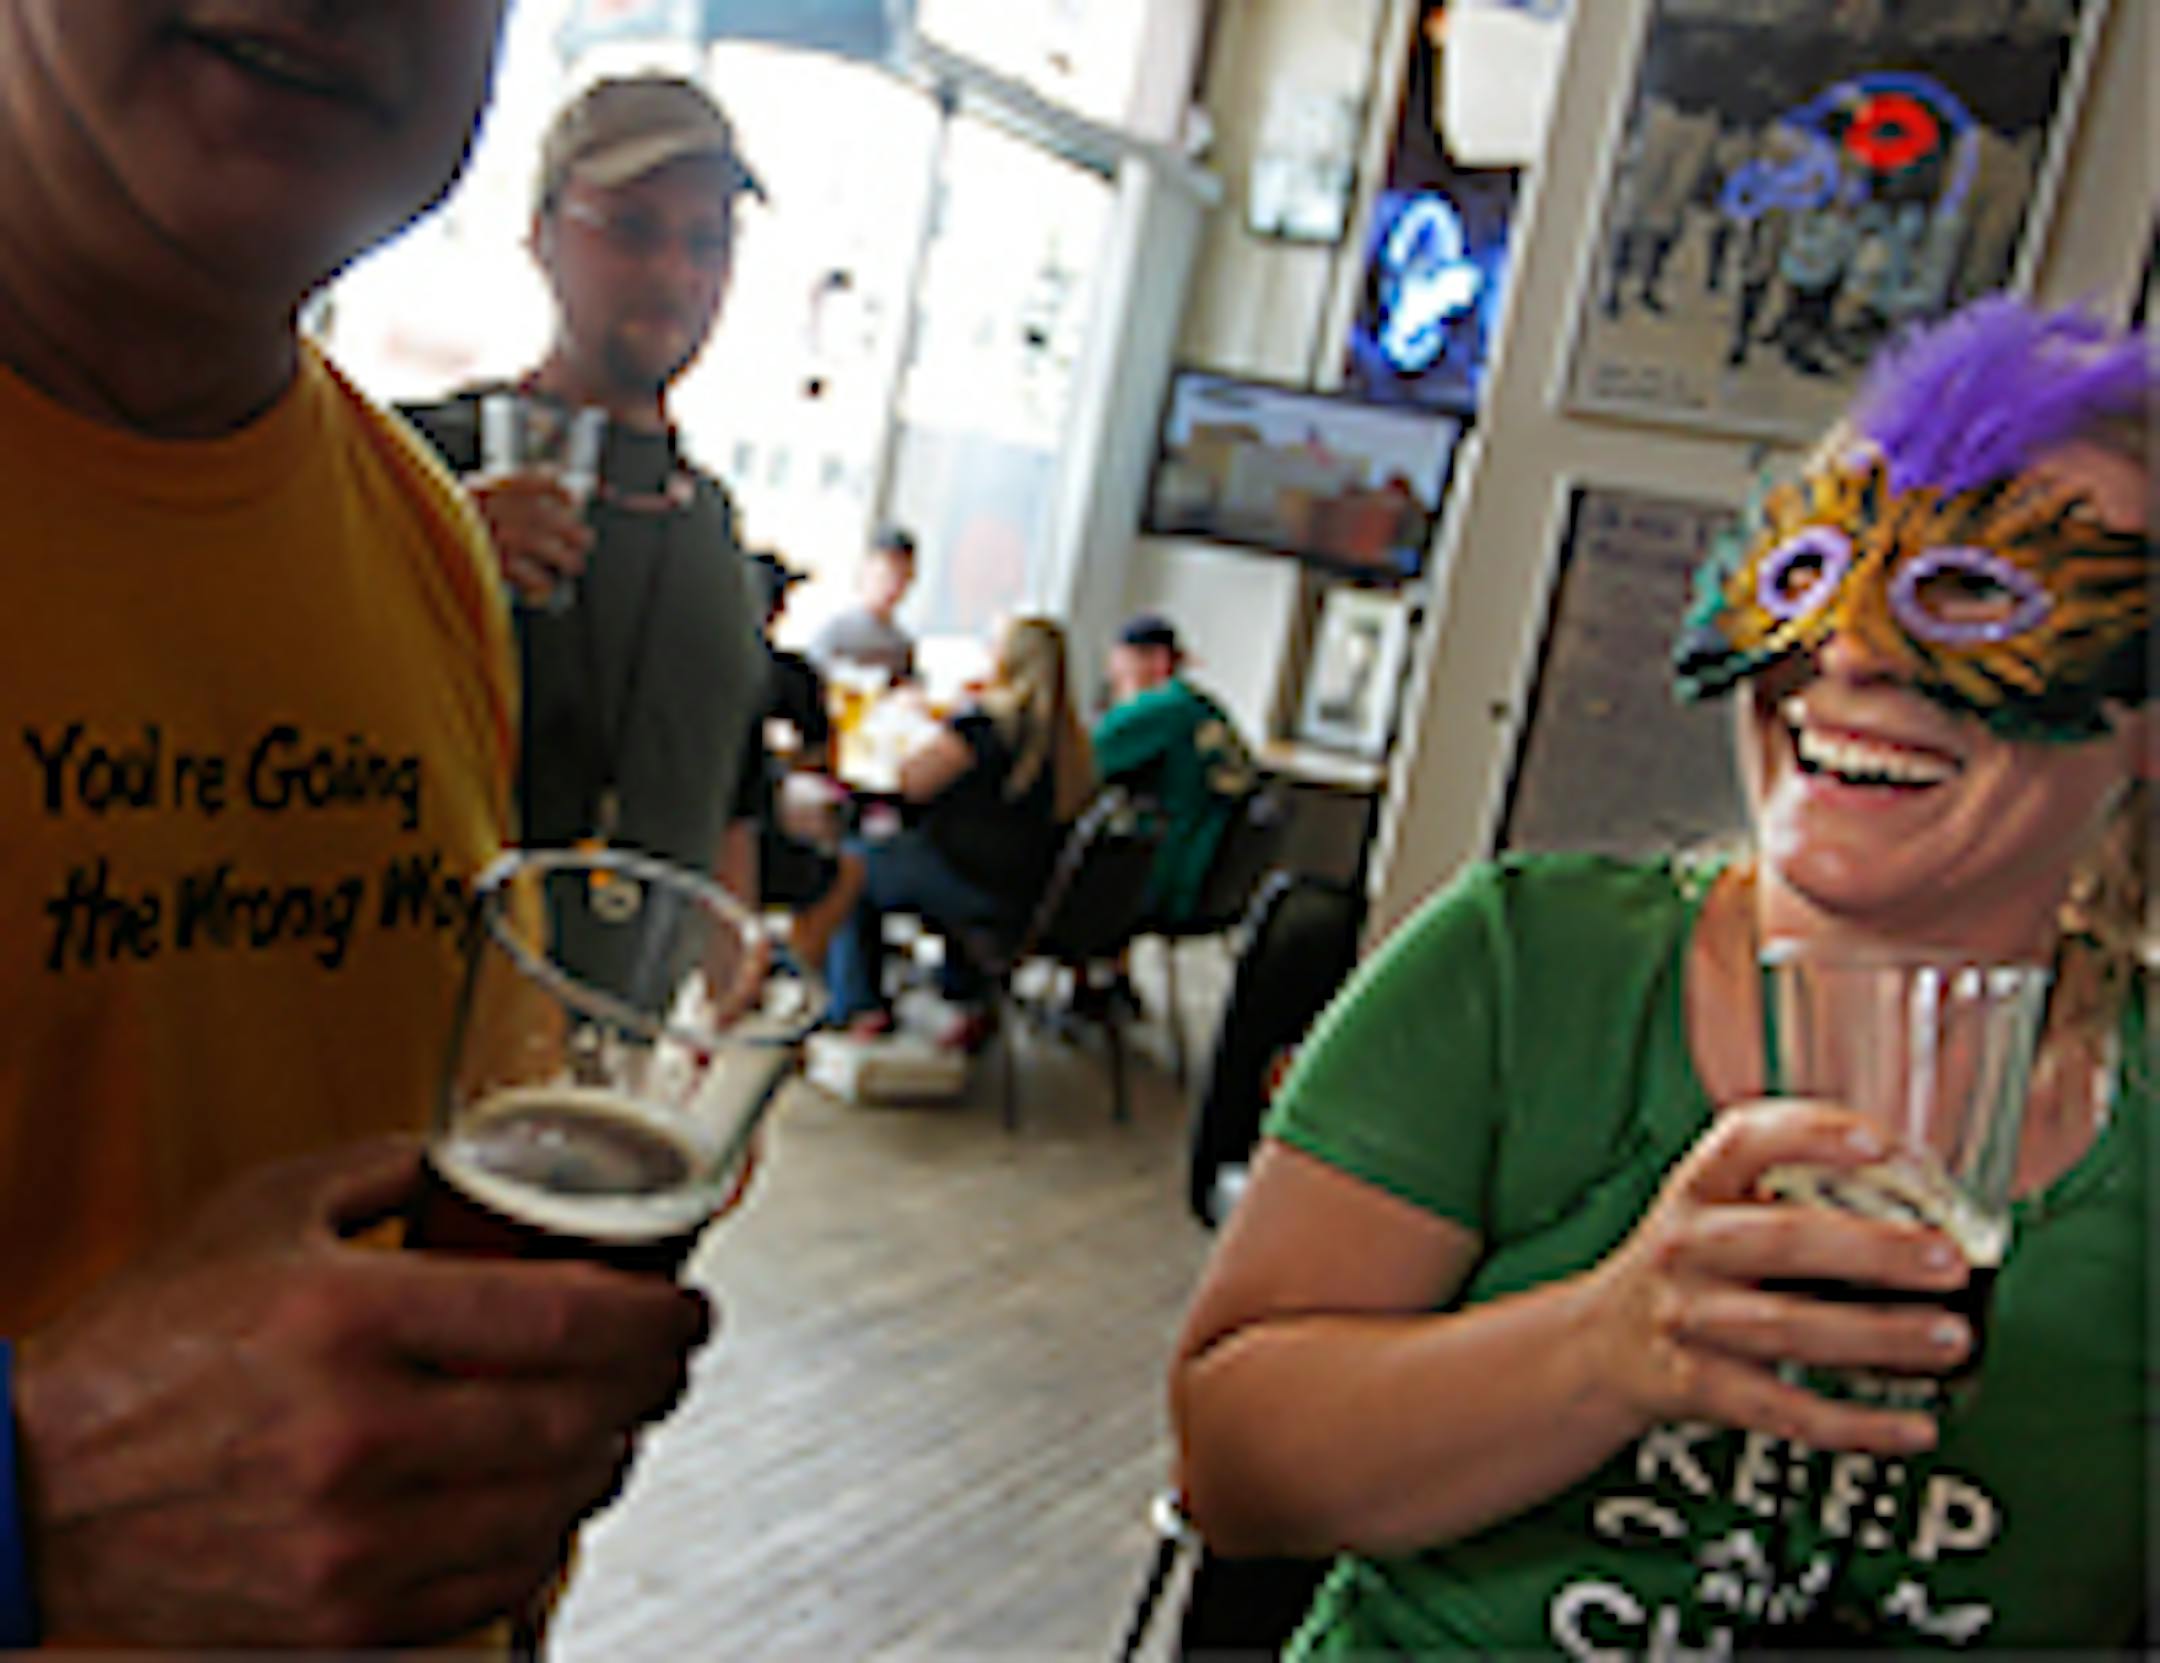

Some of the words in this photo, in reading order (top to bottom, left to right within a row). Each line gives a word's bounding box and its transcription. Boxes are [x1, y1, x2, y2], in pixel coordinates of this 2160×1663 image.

[246, 722, 421, 831] Going
[46, 856, 161, 972] the
[175, 858, 365, 969] Wrong
[1635, 1422, 1999, 1562] KEEP
